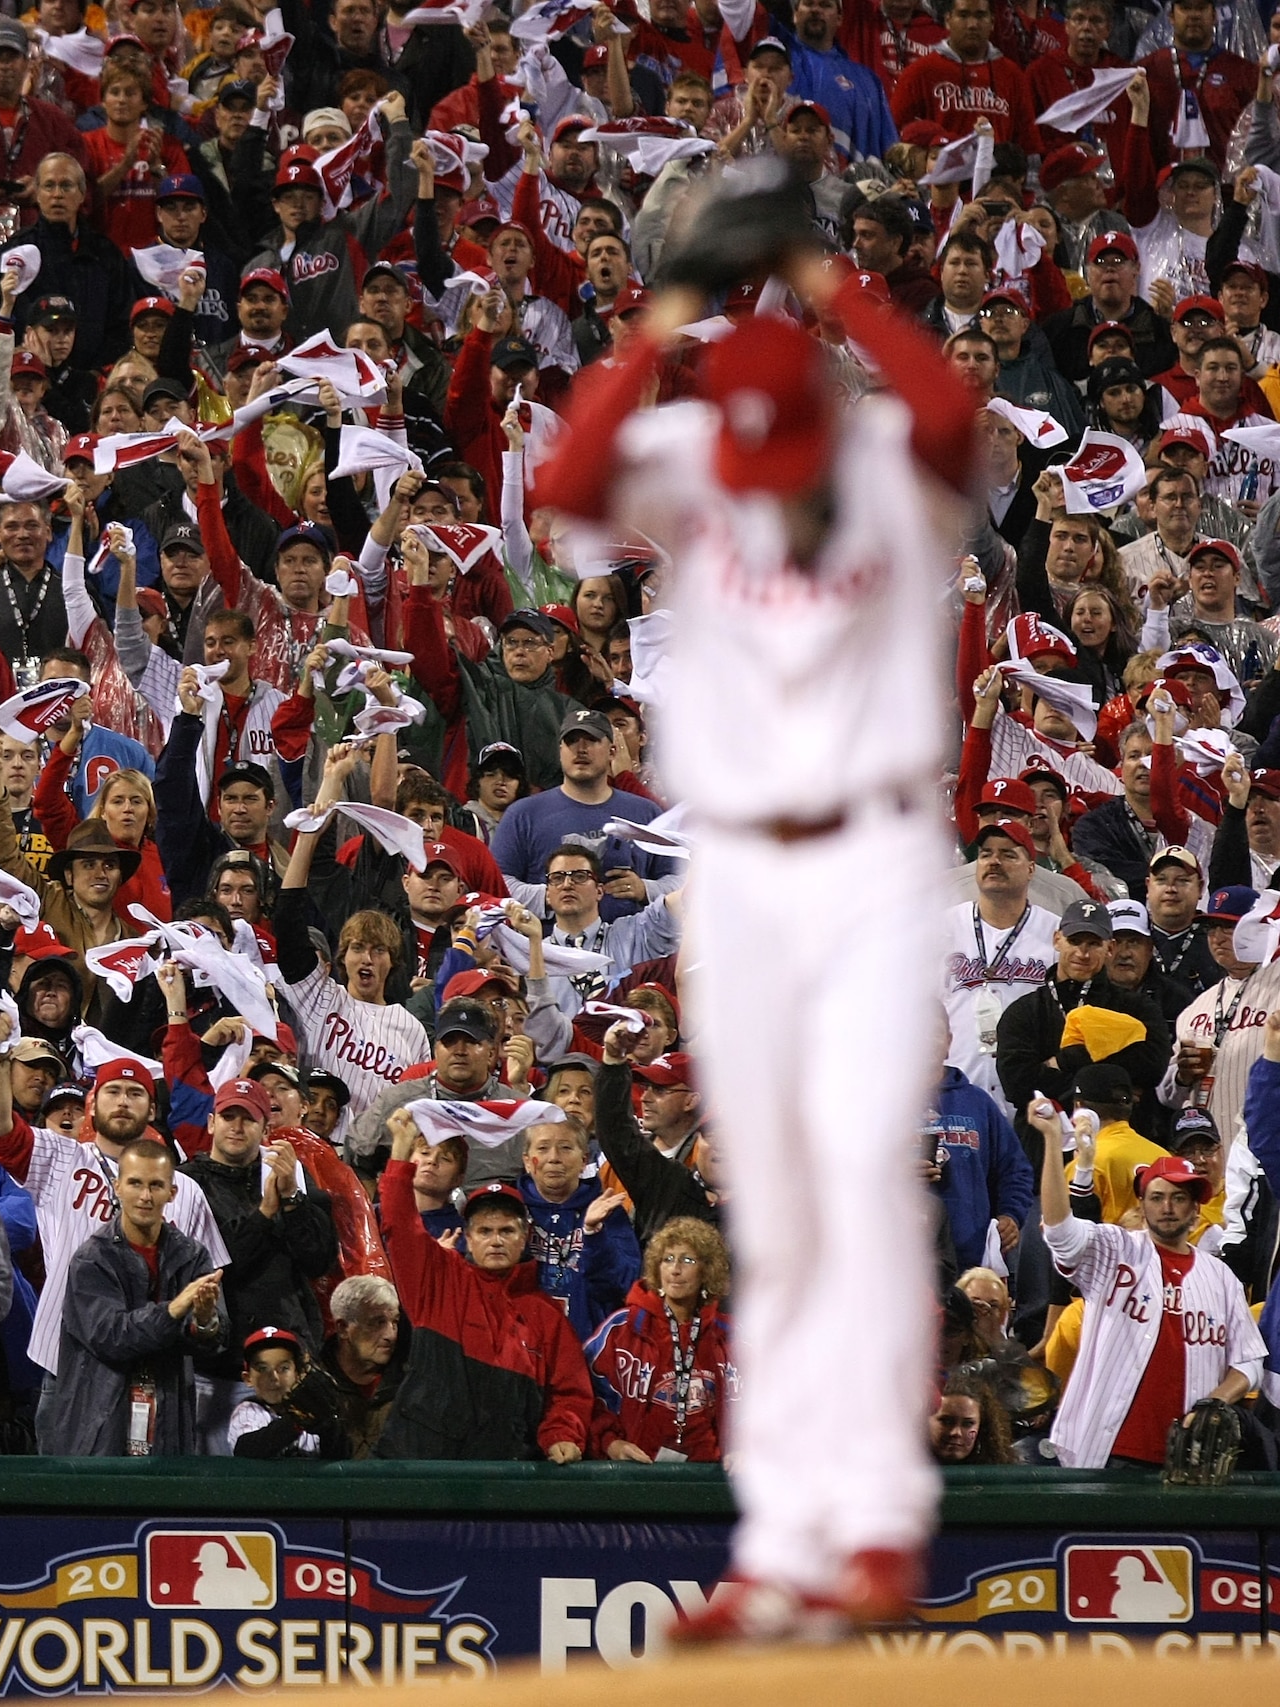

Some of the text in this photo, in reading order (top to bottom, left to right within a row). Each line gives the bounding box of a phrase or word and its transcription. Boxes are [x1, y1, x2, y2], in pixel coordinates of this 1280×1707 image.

[596, 45, 608, 57] P
[933, 84, 1010, 118] Phillies
[288, 166, 300, 181] P
[1104, 234, 1116, 245] P
[859, 275, 871, 288] P
[631, 289, 643, 299] P
[741, 285, 753, 297] P
[146, 297, 158, 309] P
[79, 436, 91, 449] P
[177, 526, 191, 538] NY
[546, 603, 558, 614] P
[1046, 634, 1058, 648] P
[1153, 678, 1166, 689] P
[576, 710, 591, 722] P
[1254, 769, 1267, 780] P
[994, 781, 1007, 797] P
[432, 844, 445, 855] P
[465, 892, 480, 903] P
[1213, 891, 1228, 910] P
[1081, 903, 1097, 918] P
[551, 1214, 560, 1224] P
[262, 1326, 279, 1338] P
[68, 1560, 358, 1596] 20 09
[987, 1575, 1274, 1609] 20 09
[235, 1617, 489, 1692] SERIES
